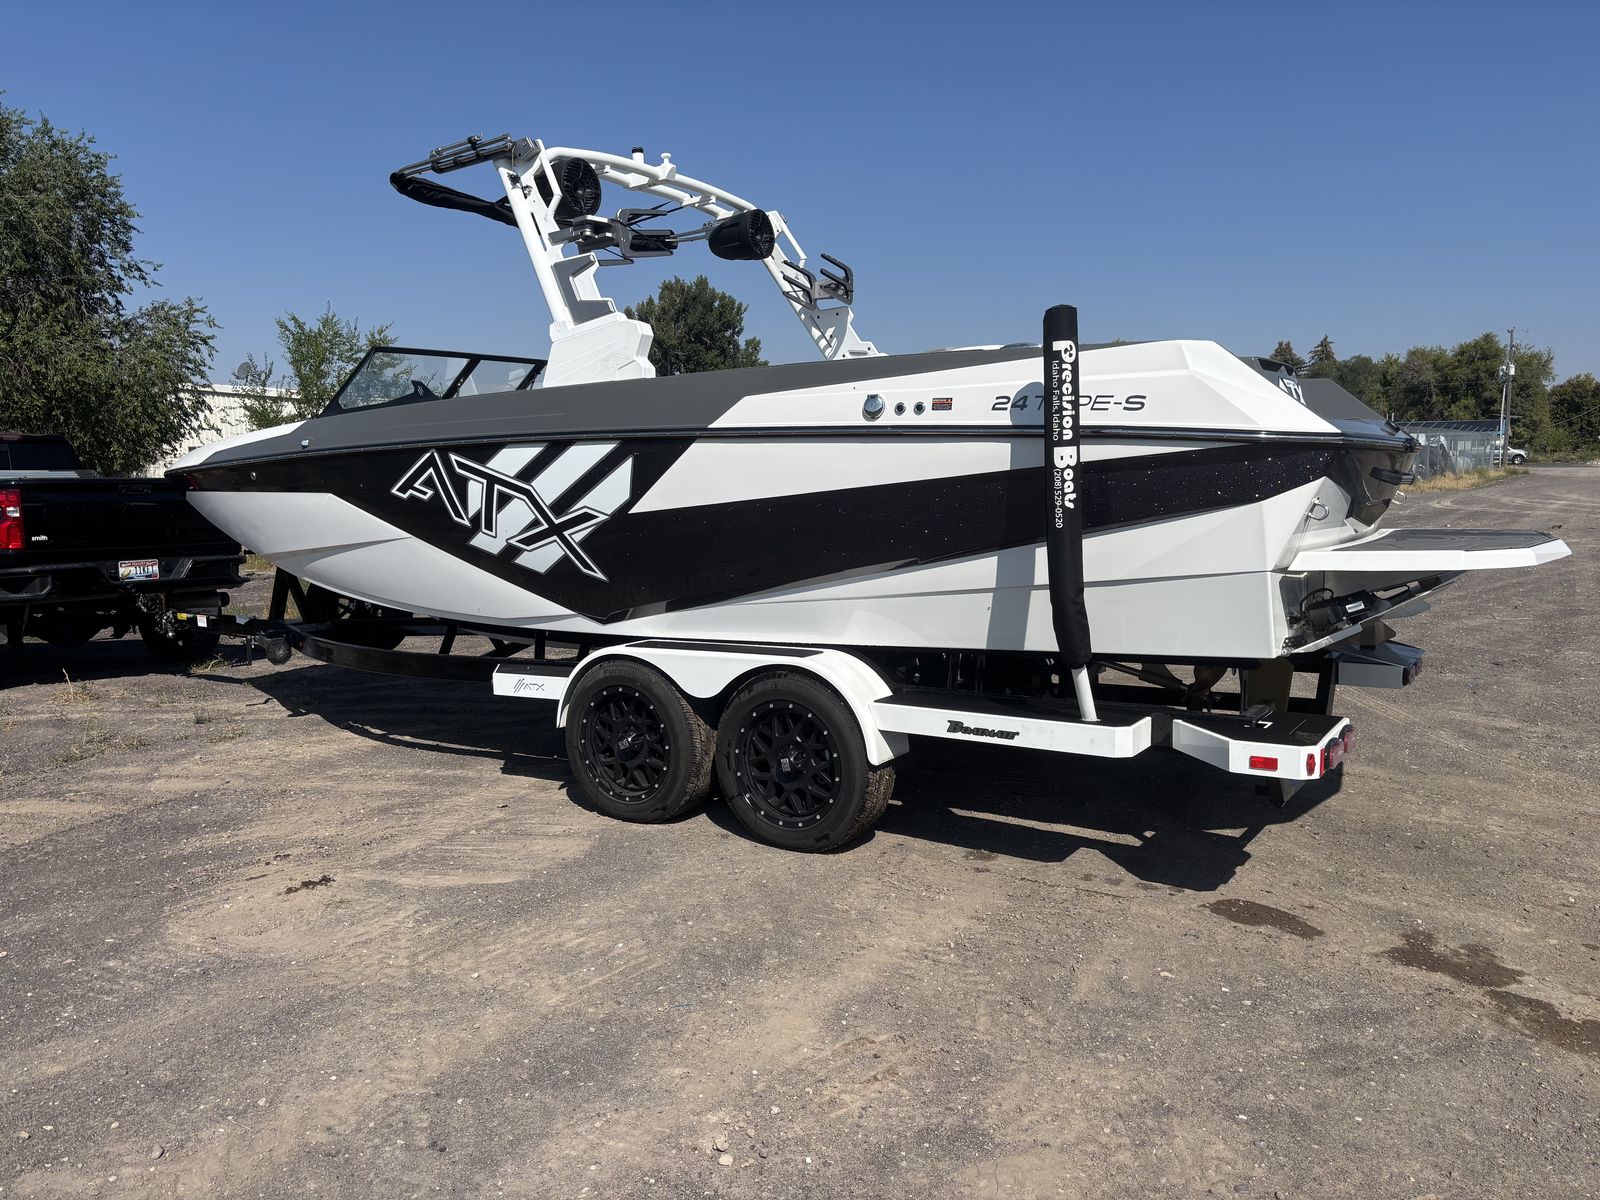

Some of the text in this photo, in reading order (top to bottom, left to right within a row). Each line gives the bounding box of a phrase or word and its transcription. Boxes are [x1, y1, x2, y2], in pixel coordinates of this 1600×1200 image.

[1052, 360, 1061, 441] Idaho Falls, Idaho
[1052, 340, 1078, 509] Precision Boats
[391, 449, 610, 582] ATX
[1053, 468, 1064, 529] (208) 529-0520
